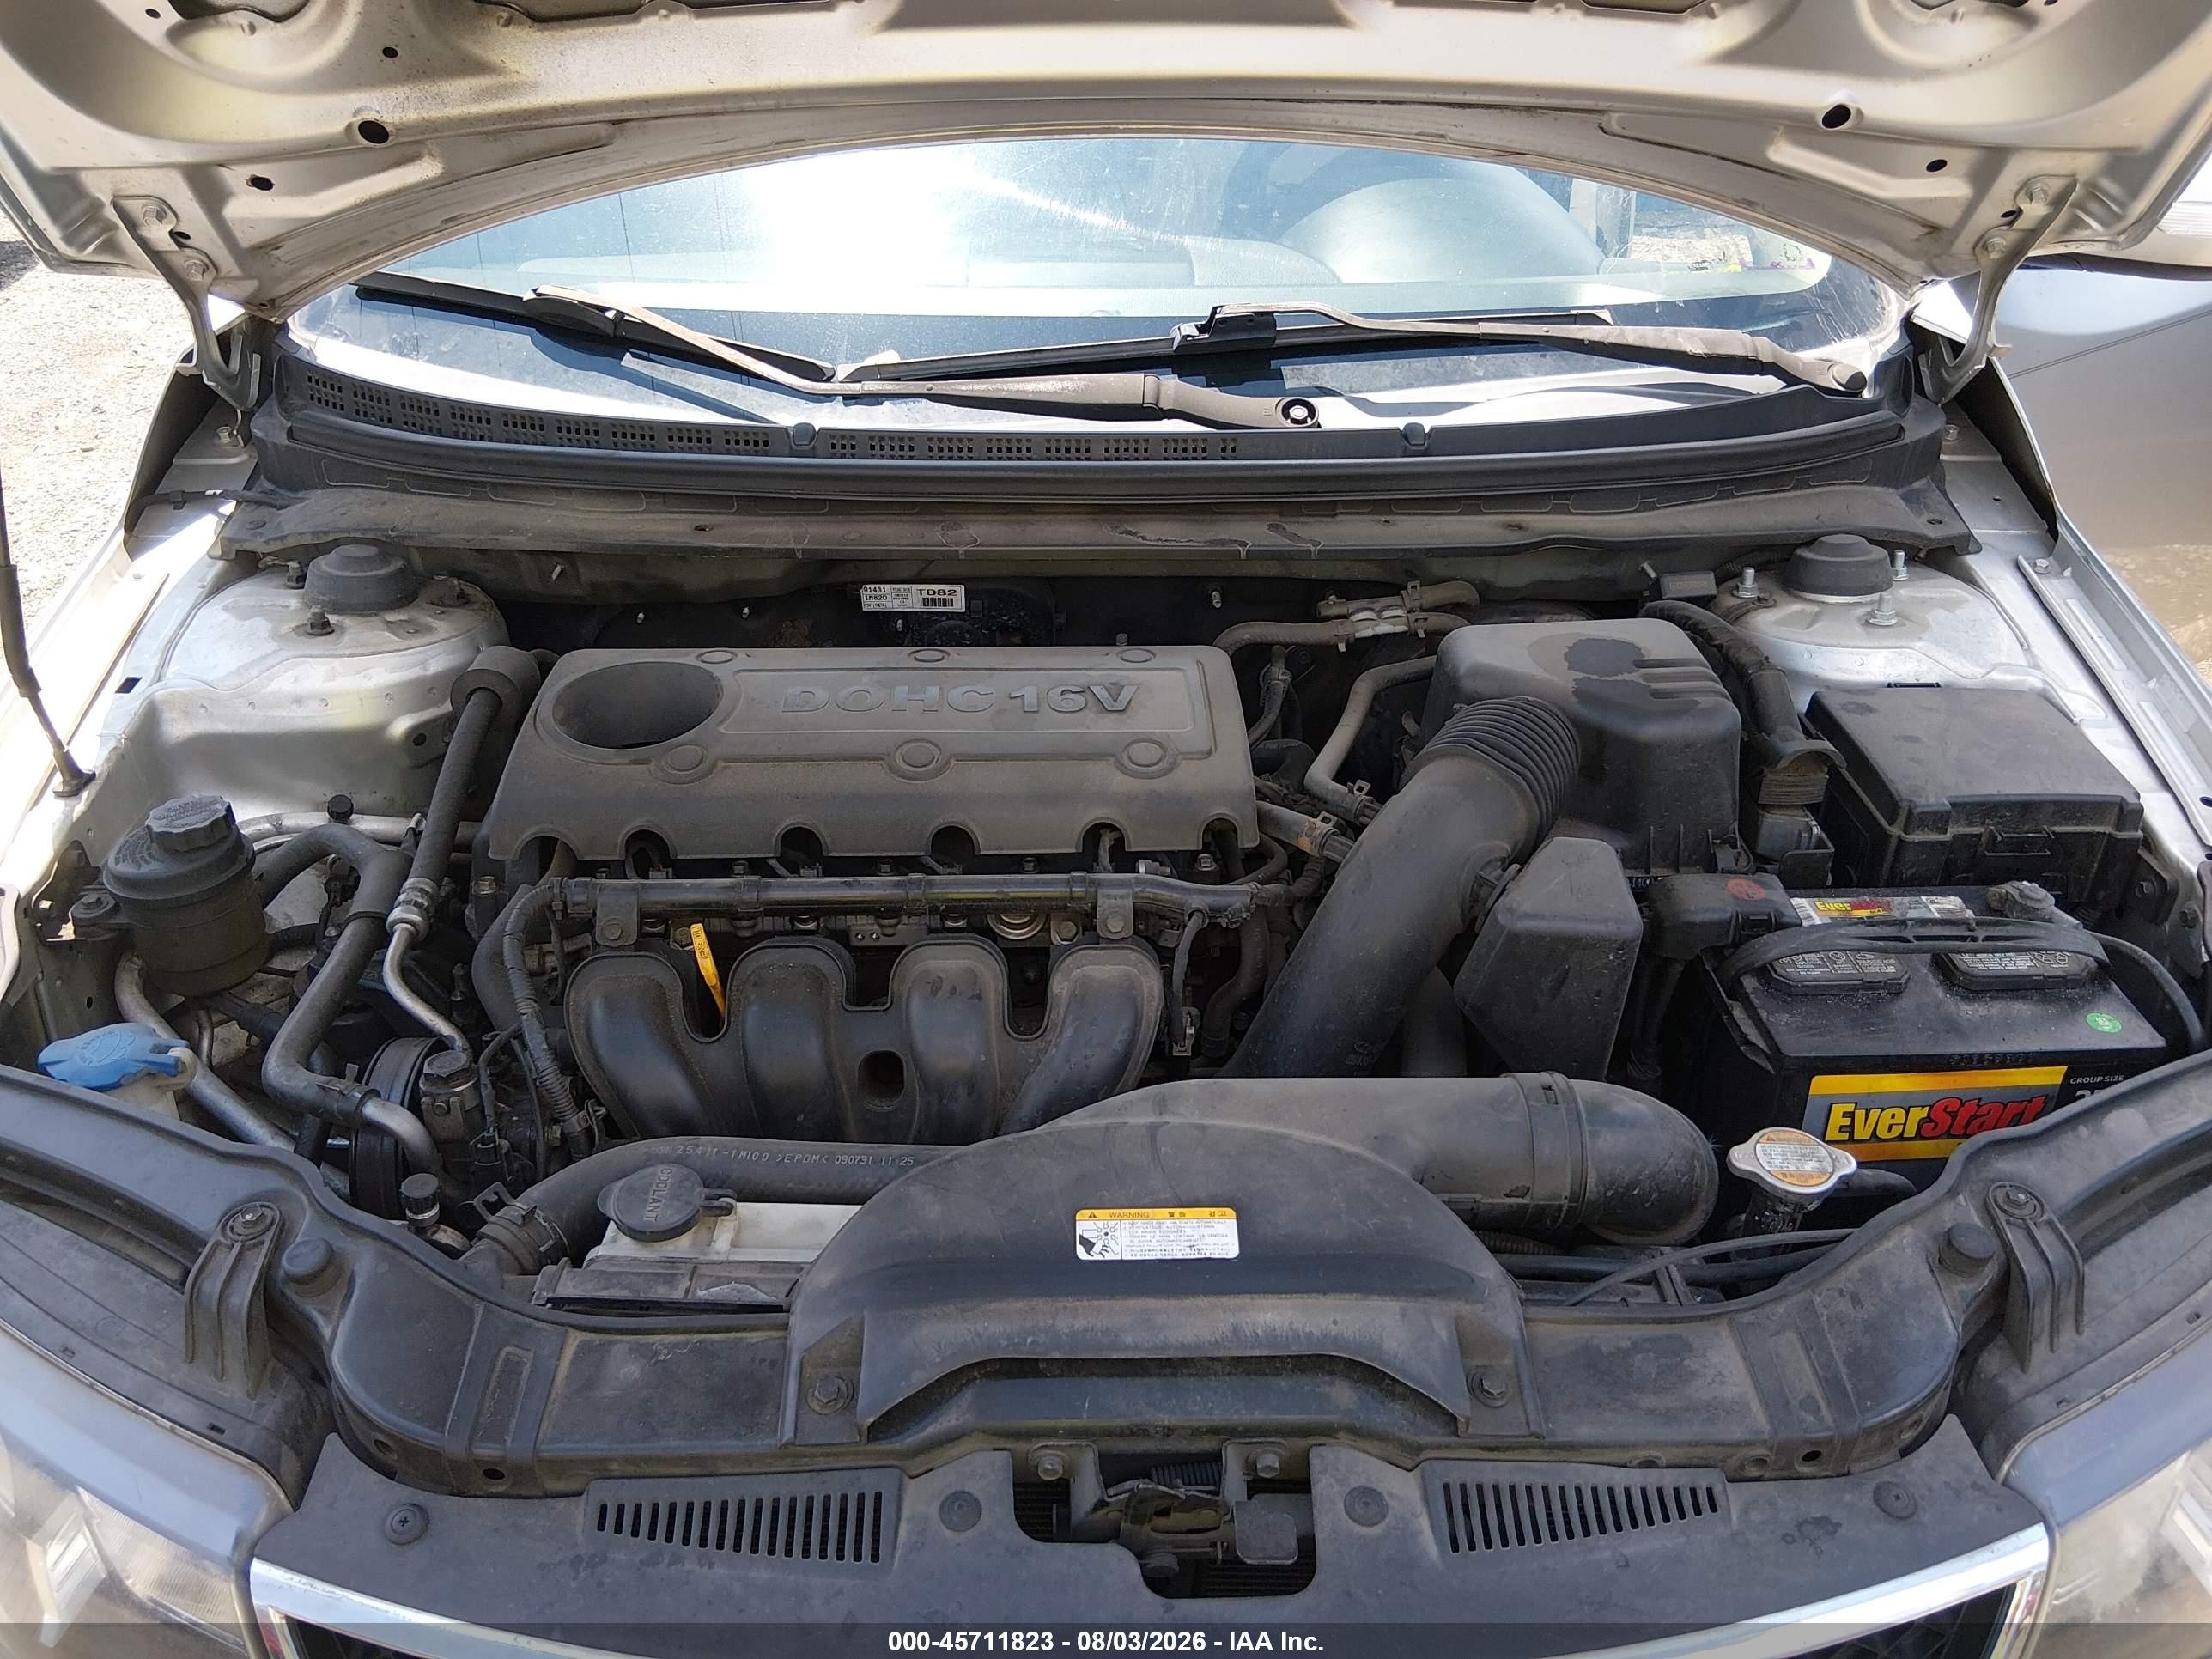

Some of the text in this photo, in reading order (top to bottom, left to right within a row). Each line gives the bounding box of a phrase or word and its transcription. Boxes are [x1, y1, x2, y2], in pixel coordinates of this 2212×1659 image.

[782, 684, 1139, 713] DOHC 16V
[2069, 1076, 2103, 1085] GROUP
[1824, 1096, 2046, 1141] EverStart
[835, 1155, 873, 1165] 090731
[643, 1167, 673, 1224] COOLANT
